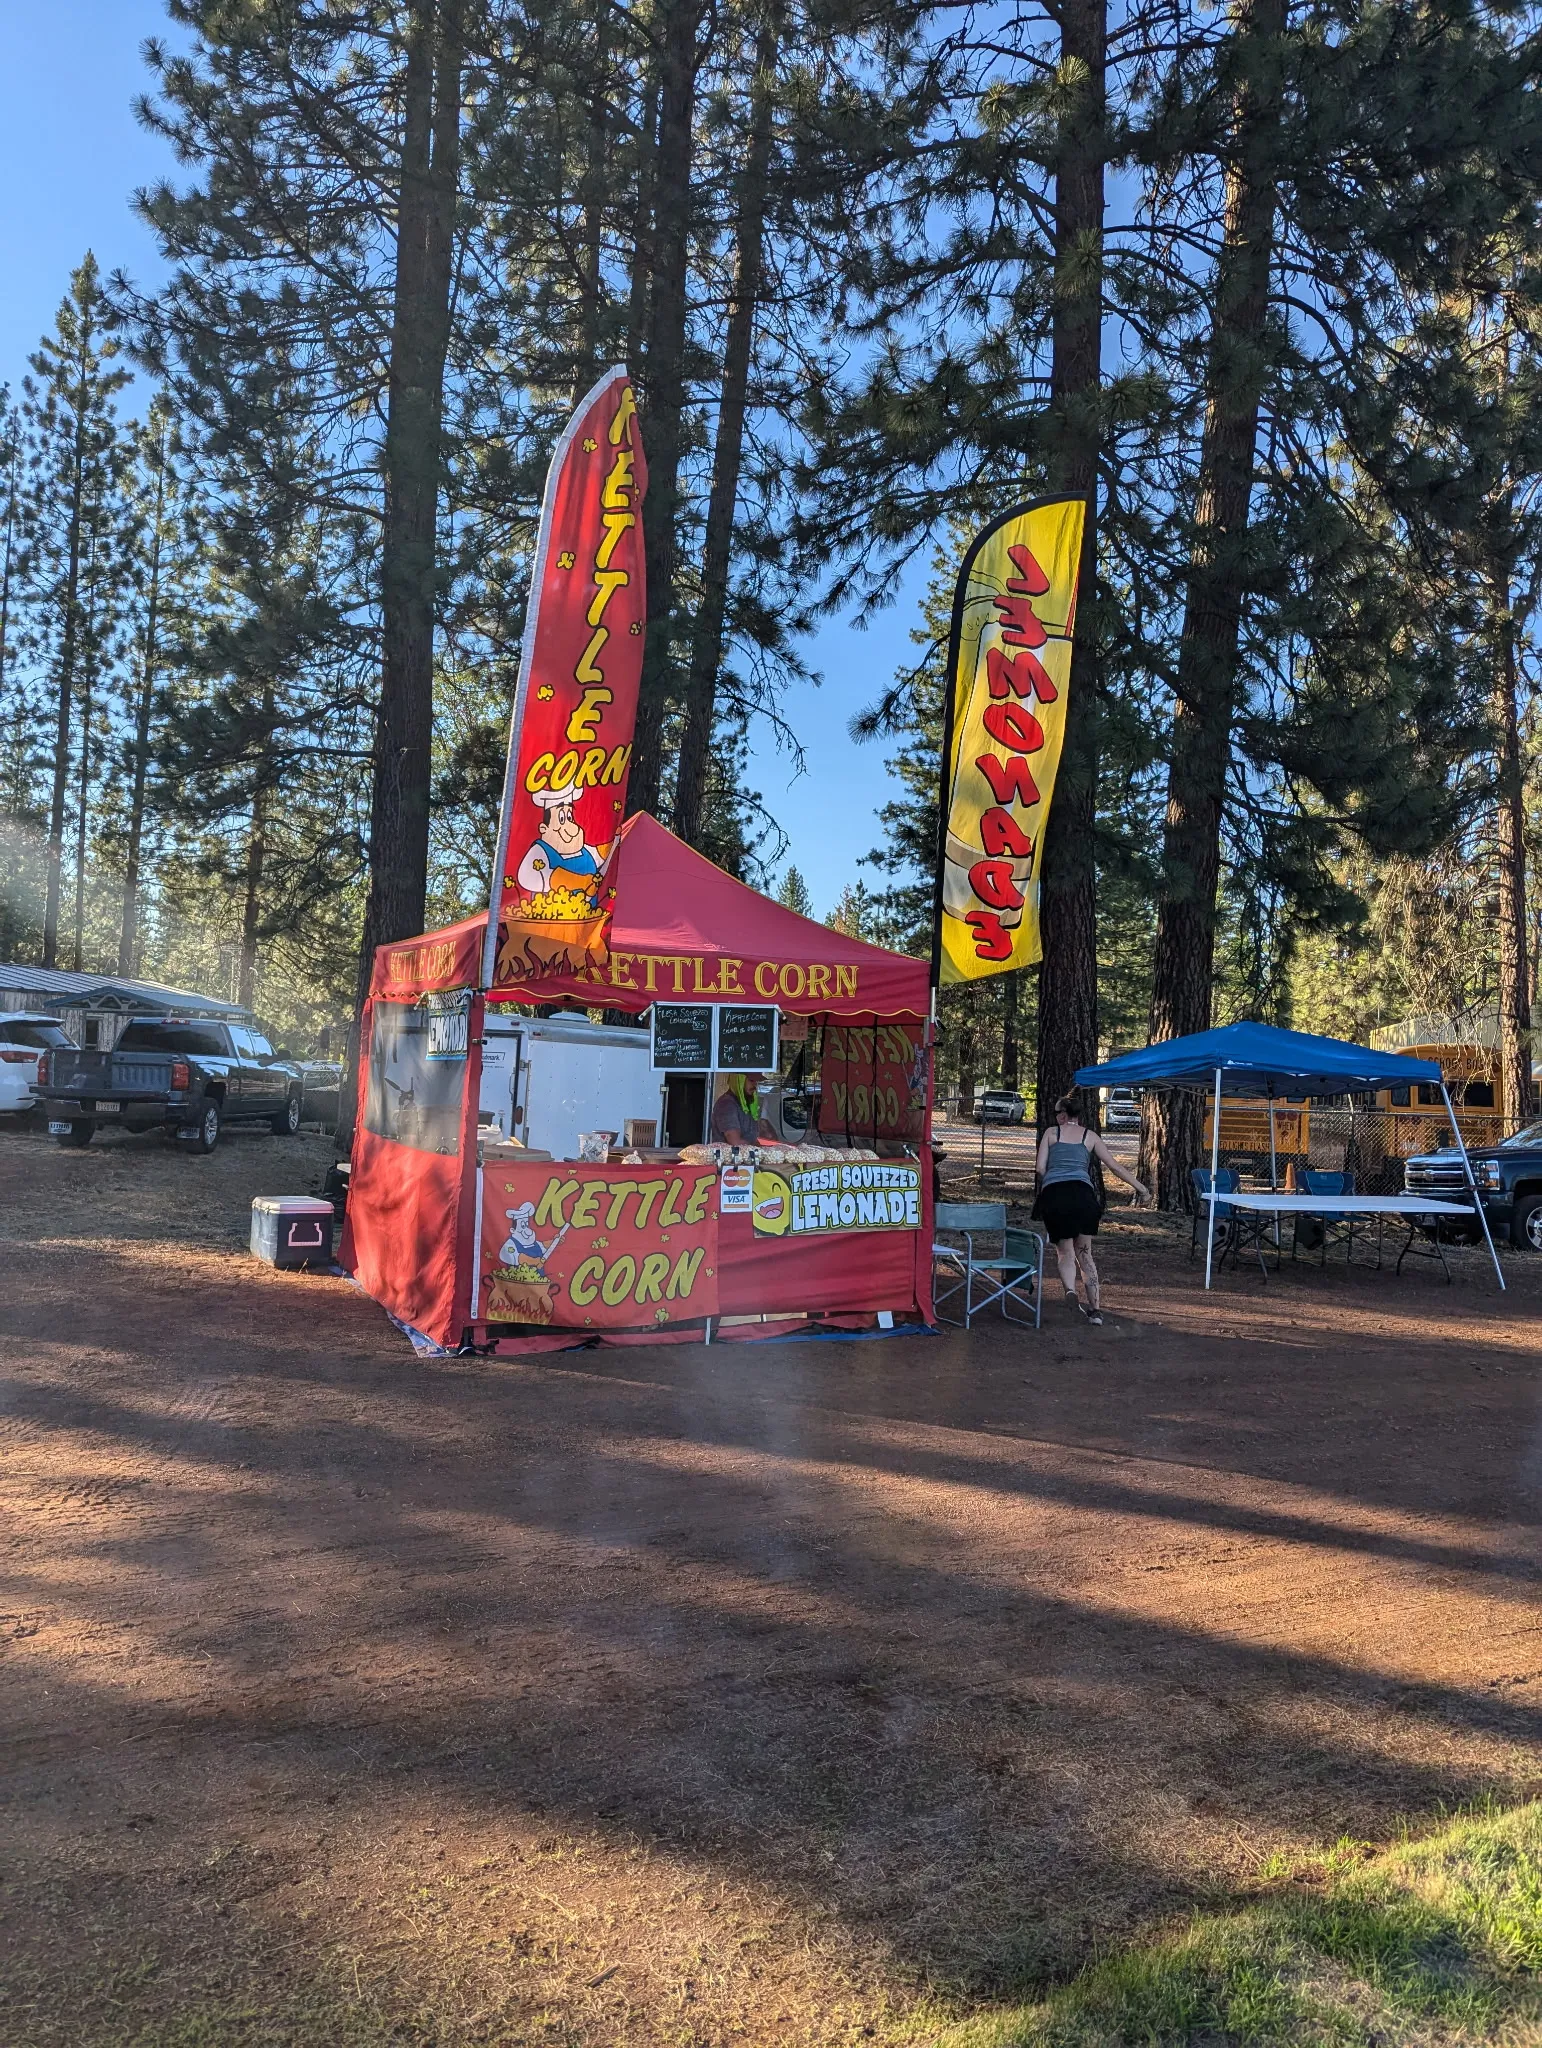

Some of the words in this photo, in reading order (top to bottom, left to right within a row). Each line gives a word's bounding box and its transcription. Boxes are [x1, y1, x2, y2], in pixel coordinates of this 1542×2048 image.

[566, 386, 637, 744] KETTLE
[525, 741, 633, 793] CORN
[390, 948, 427, 983] KETTLE
[427, 941, 457, 981] CORN
[754, 961, 859, 1000] CORN
[533, 1174, 718, 1230] KETTLE
[791, 1167, 839, 1193] FRESH
[841, 1165, 919, 1189] SQUEEZED
[791, 1190, 920, 1232] LEMONADE
[569, 1247, 705, 1307] CORN
